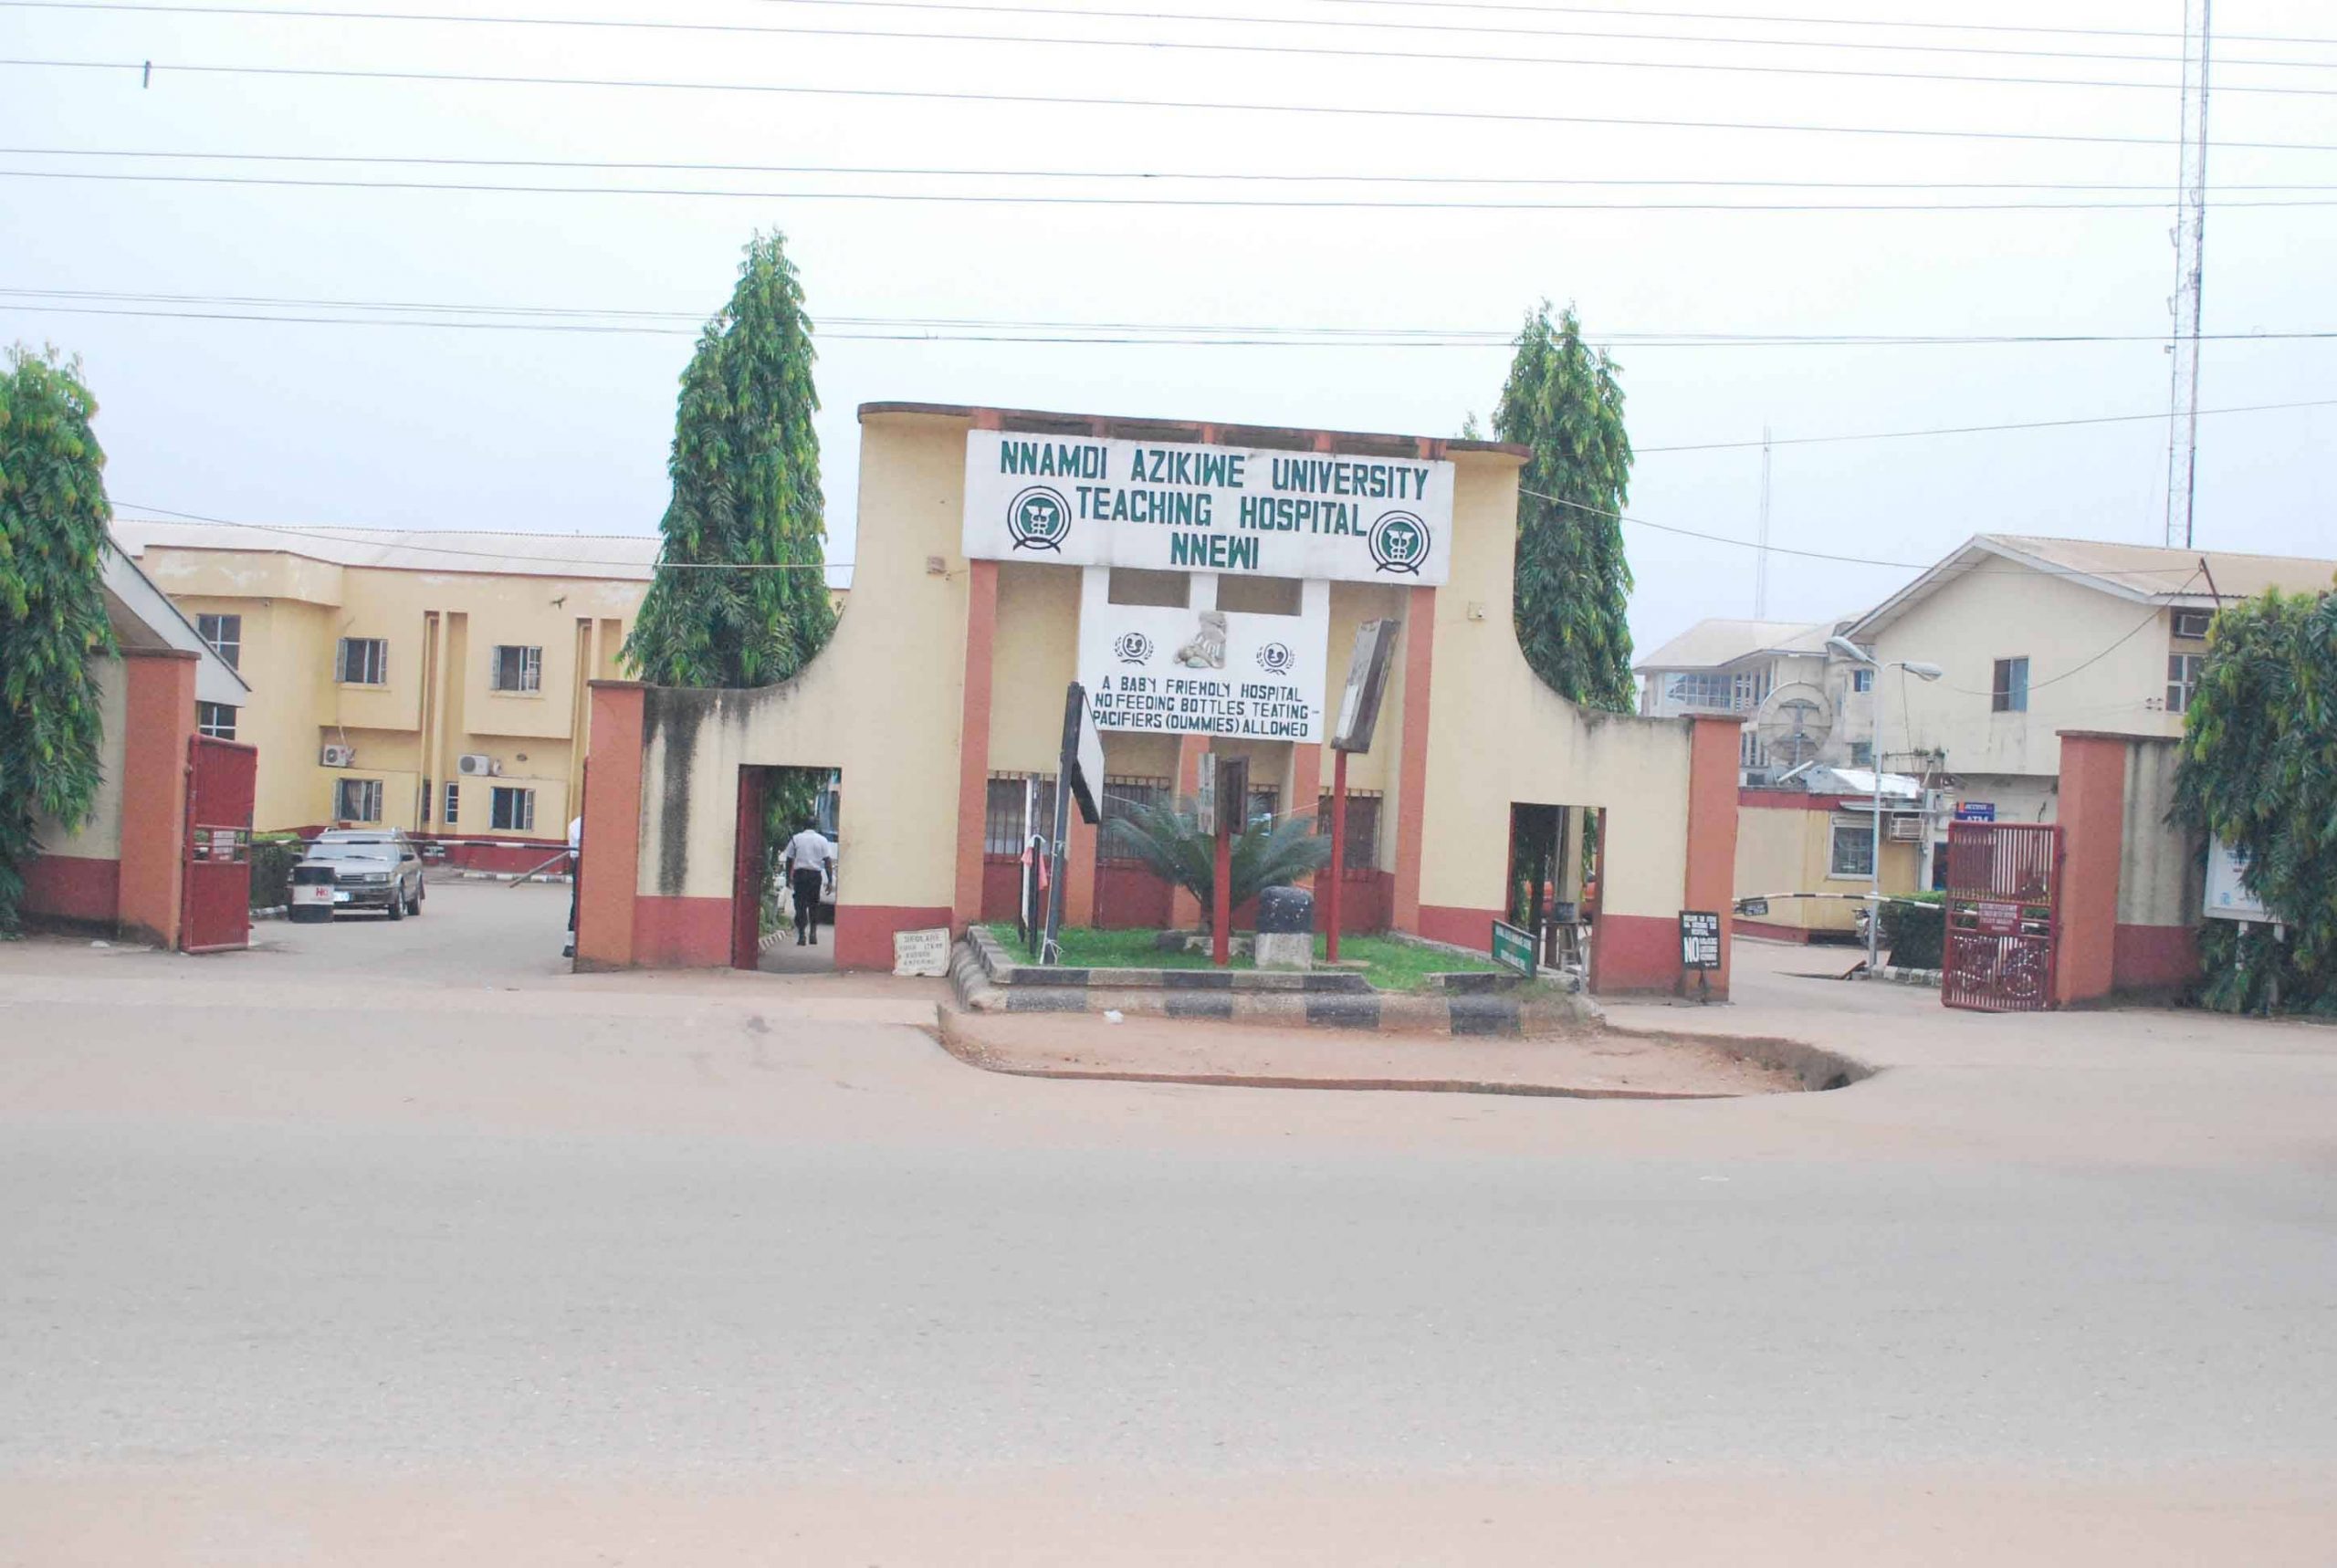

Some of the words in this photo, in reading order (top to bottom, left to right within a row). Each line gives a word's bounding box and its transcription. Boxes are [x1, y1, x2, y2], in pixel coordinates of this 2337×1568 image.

[1001, 441, 1107, 480] NNAMDI
[1131, 449, 1245, 488] AZIKIWE
[1273, 458, 1430, 500] UNIVERSITY
[1076, 486, 1212, 527] TEACHING
[1240, 497, 1368, 537] HOSPITAL
[1170, 532, 1260, 570] NNEWI
[1102, 675, 1111, 690] A
[1121, 676, 1157, 693] BABY
[1241, 684, 1303, 702] HOSPITAL
[1095, 693, 1113, 708] NO
[1116, 695, 1175, 712] FEEDING
[1180, 698, 1245, 716] BOTTLES
[1093, 710, 1162, 729] PACIFIERS
[1166, 714, 1240, 734] (DUMMIES)
[1242, 717, 1309, 737] ALLOWED
[1683, 936, 1700, 963] NO
